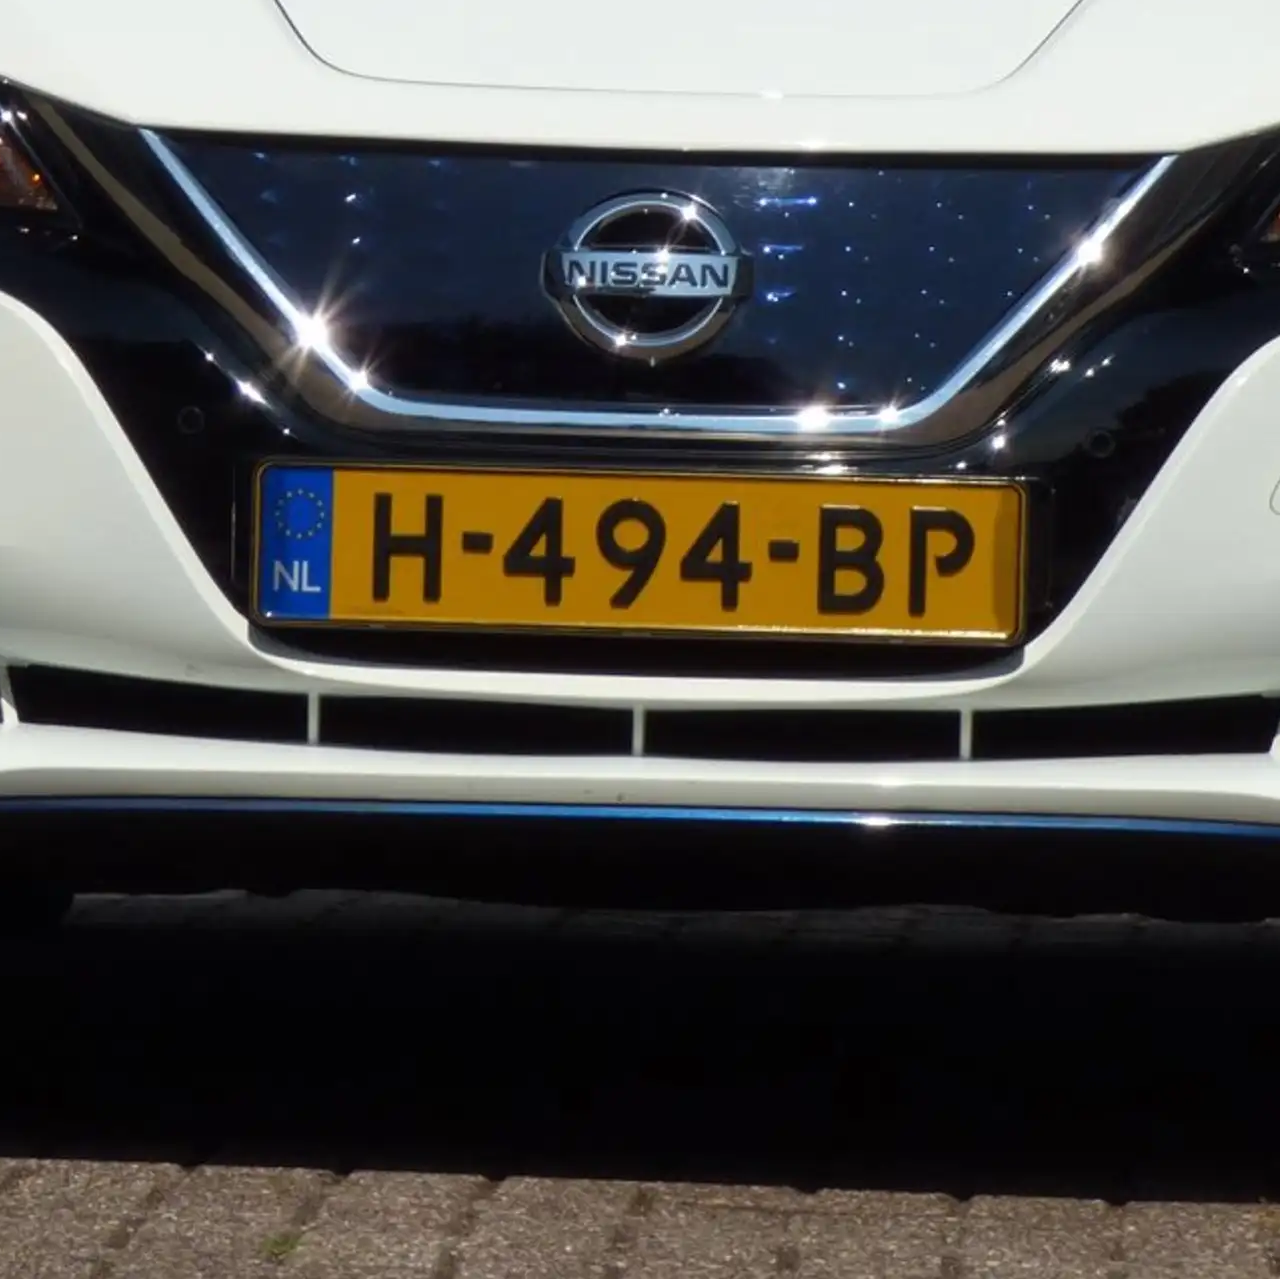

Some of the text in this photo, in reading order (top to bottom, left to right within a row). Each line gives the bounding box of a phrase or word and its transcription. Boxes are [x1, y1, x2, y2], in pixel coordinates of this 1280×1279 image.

[568, 259, 729, 289] NISSAN
[371, 491, 977, 618] H-494-BP
[272, 559, 322, 594] NL
